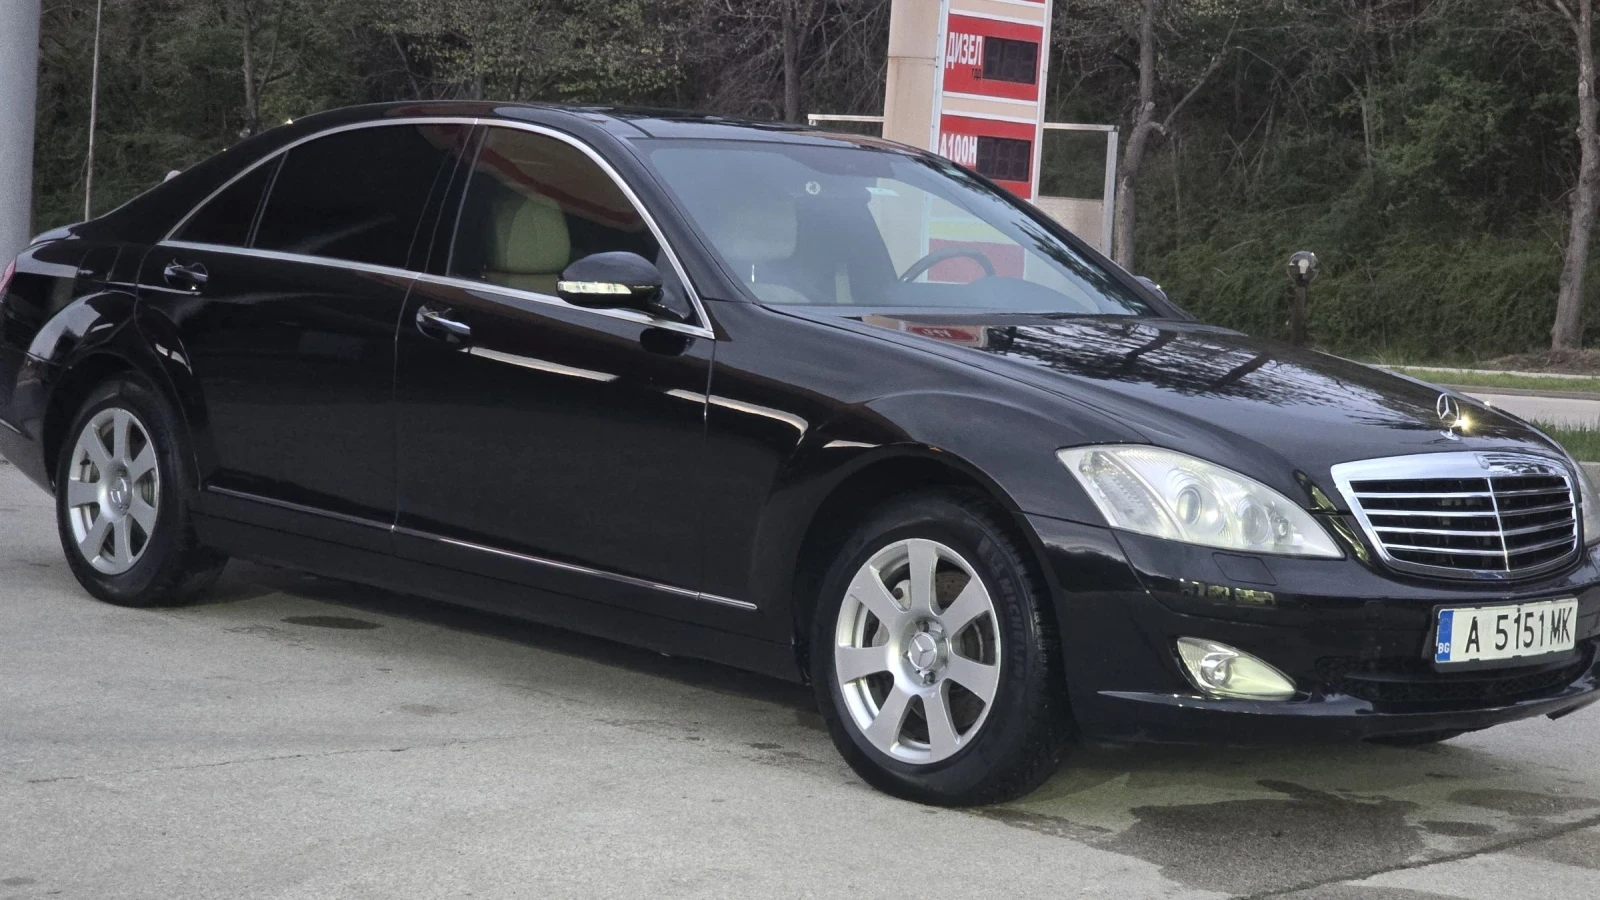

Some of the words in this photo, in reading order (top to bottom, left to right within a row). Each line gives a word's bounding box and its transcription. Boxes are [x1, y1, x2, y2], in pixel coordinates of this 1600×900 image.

[945, 31, 983, 70] ДИЗЕЛ
[1438, 643, 1450, 654] BG
[1465, 616, 1480, 653] A
[1495, 609, 1545, 651] 5151
[1550, 607, 1573, 645] MK
